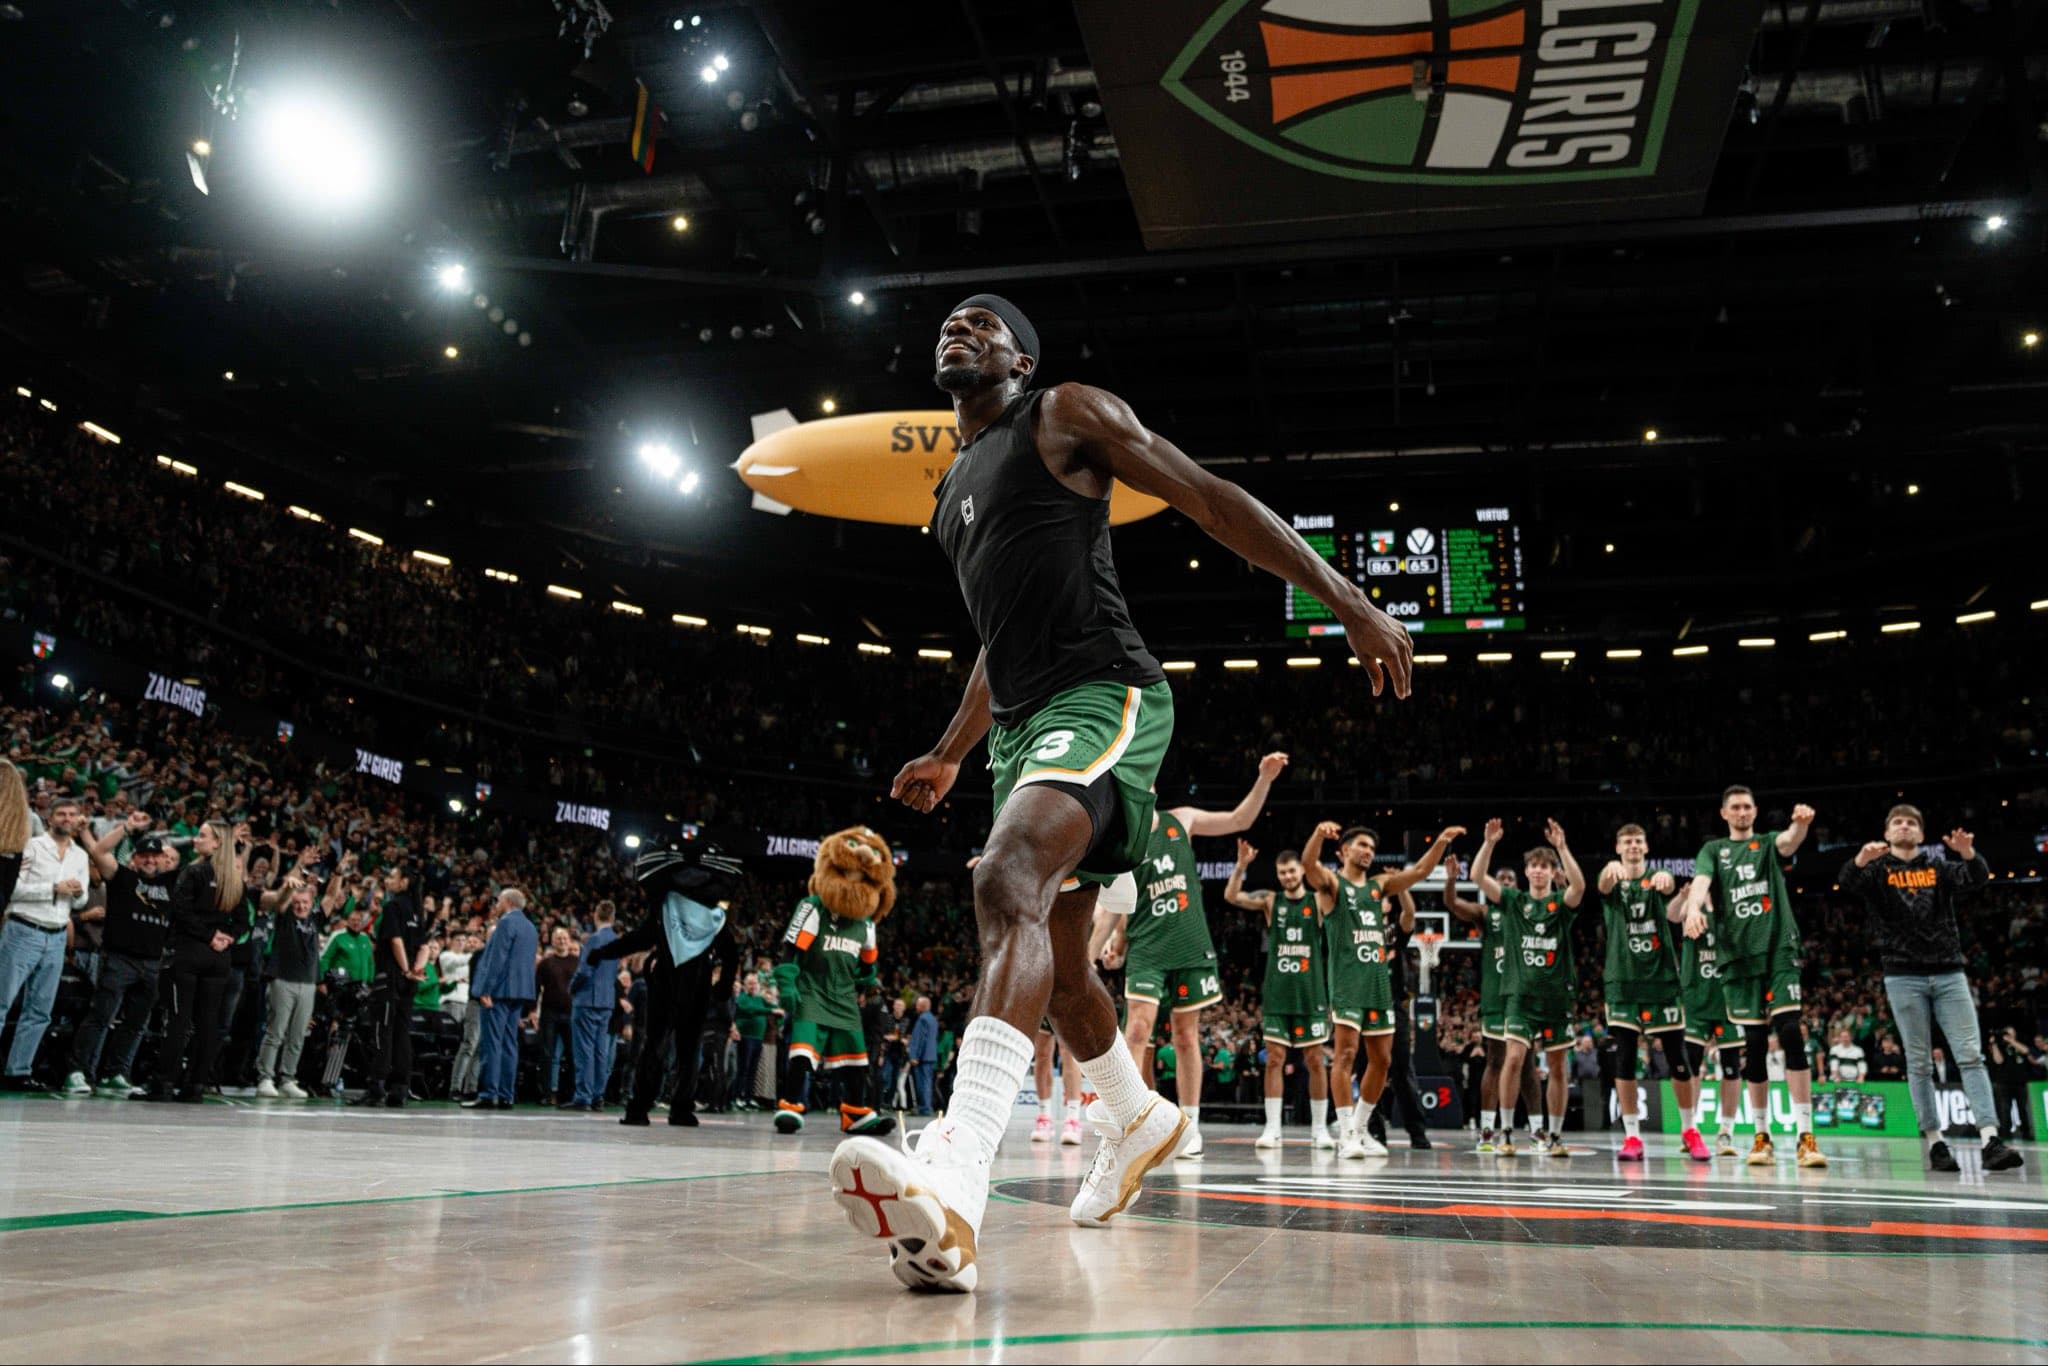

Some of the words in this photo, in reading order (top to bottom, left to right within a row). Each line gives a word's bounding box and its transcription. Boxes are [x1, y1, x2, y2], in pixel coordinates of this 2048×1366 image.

[1219, 50, 1250, 103] 1944
[1476, 507, 1510, 522] VIRTUS
[1372, 562, 1392, 573] 86
[1410, 560, 1430, 572] 65
[1386, 601, 1420, 617] 0:00
[1036, 729, 1075, 760] 3
[1153, 854, 1175, 874] 14
[1736, 864, 1756, 881] 15
[1151, 892, 1188, 916] Go3
[1630, 903, 1646, 919] 17
[1358, 910, 1377, 926] 12
[1286, 928, 1302, 941] 91
[1535, 923, 1546, 935] 4
[1277, 958, 1309, 973] Go3
[1200, 975, 1219, 995] 14
[1663, 1007, 1680, 1024] 17
[1311, 1022, 1325, 1037] 91
